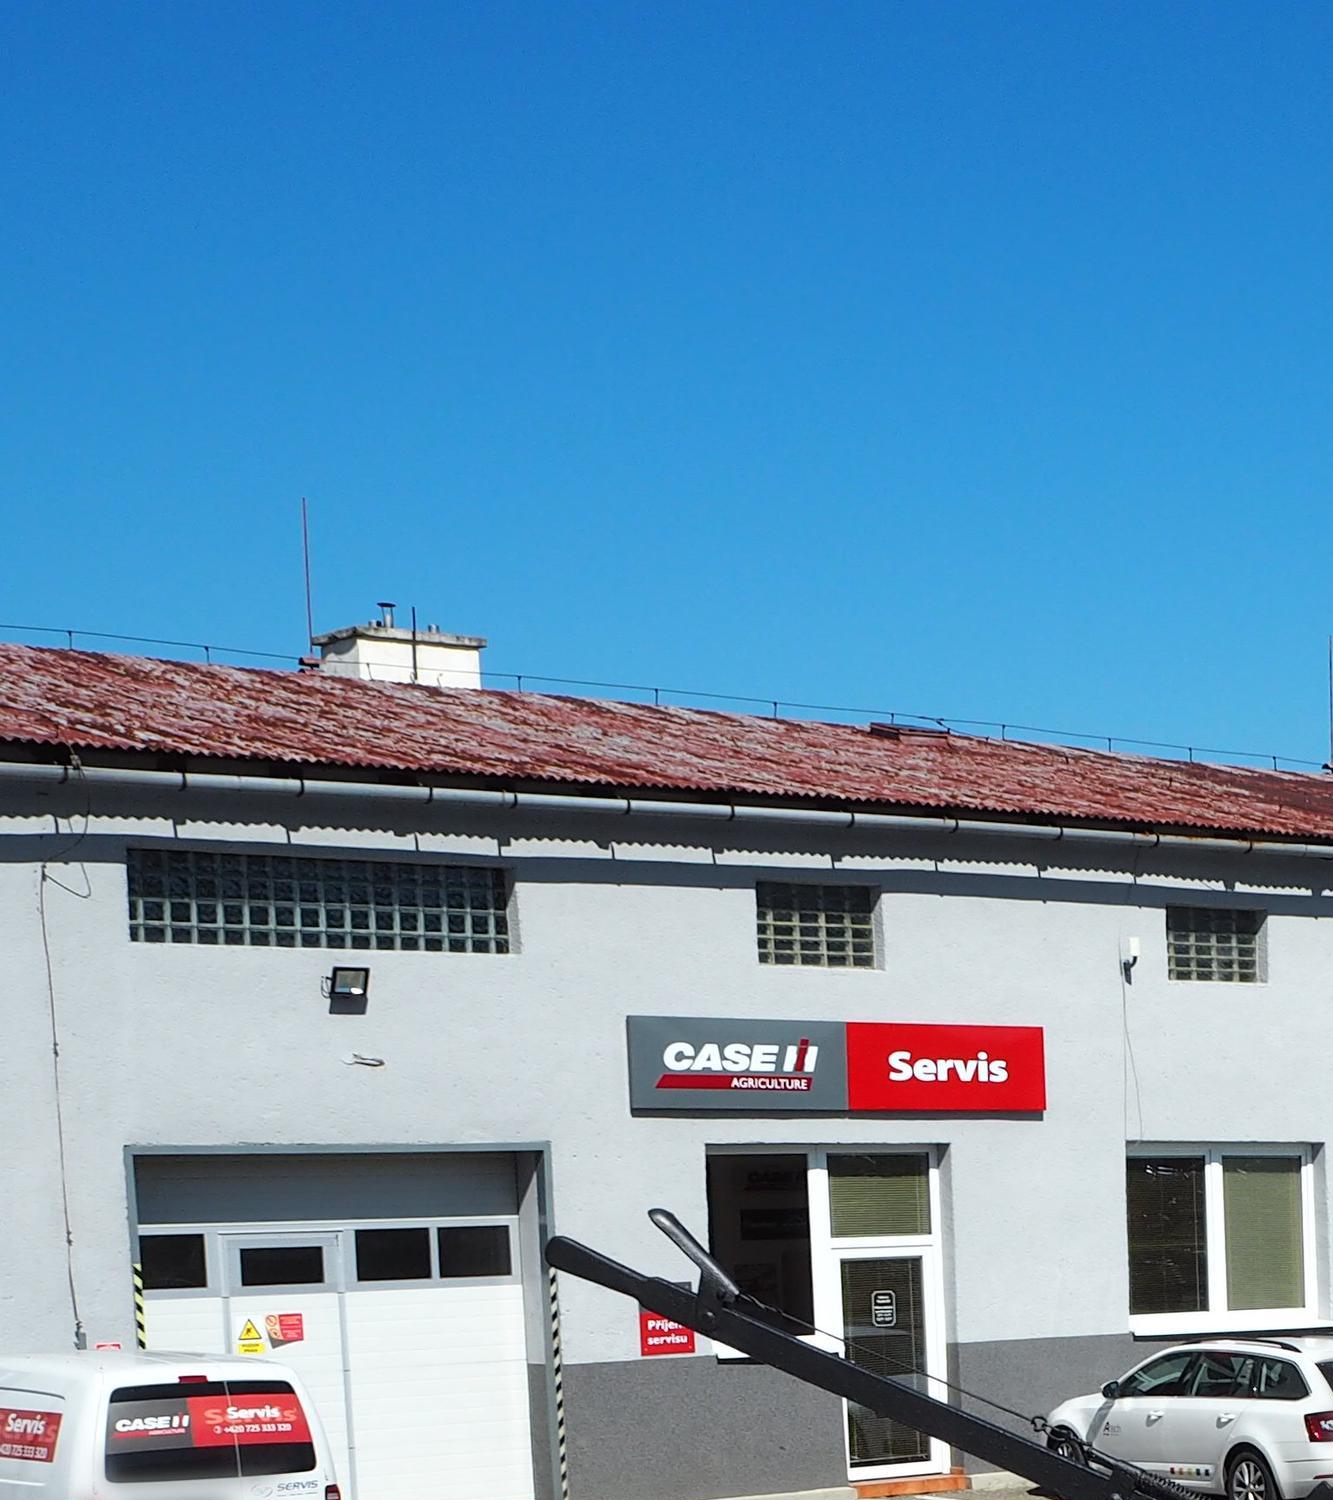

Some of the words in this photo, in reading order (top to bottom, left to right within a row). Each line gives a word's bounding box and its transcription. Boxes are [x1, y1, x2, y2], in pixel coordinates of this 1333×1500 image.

[663, 1042, 779, 1072] CASE
[888, 1051, 1008, 1083] Servis
[731, 1077, 809, 1091] AGRICULTURE
[647, 1333, 688, 1345] servisu
[5, 1413, 46, 1435] Servis
[115, 1415, 170, 1432] CASE
[226, 1405, 280, 1420] Servis
[277, 1480, 318, 1492] SERVIS
